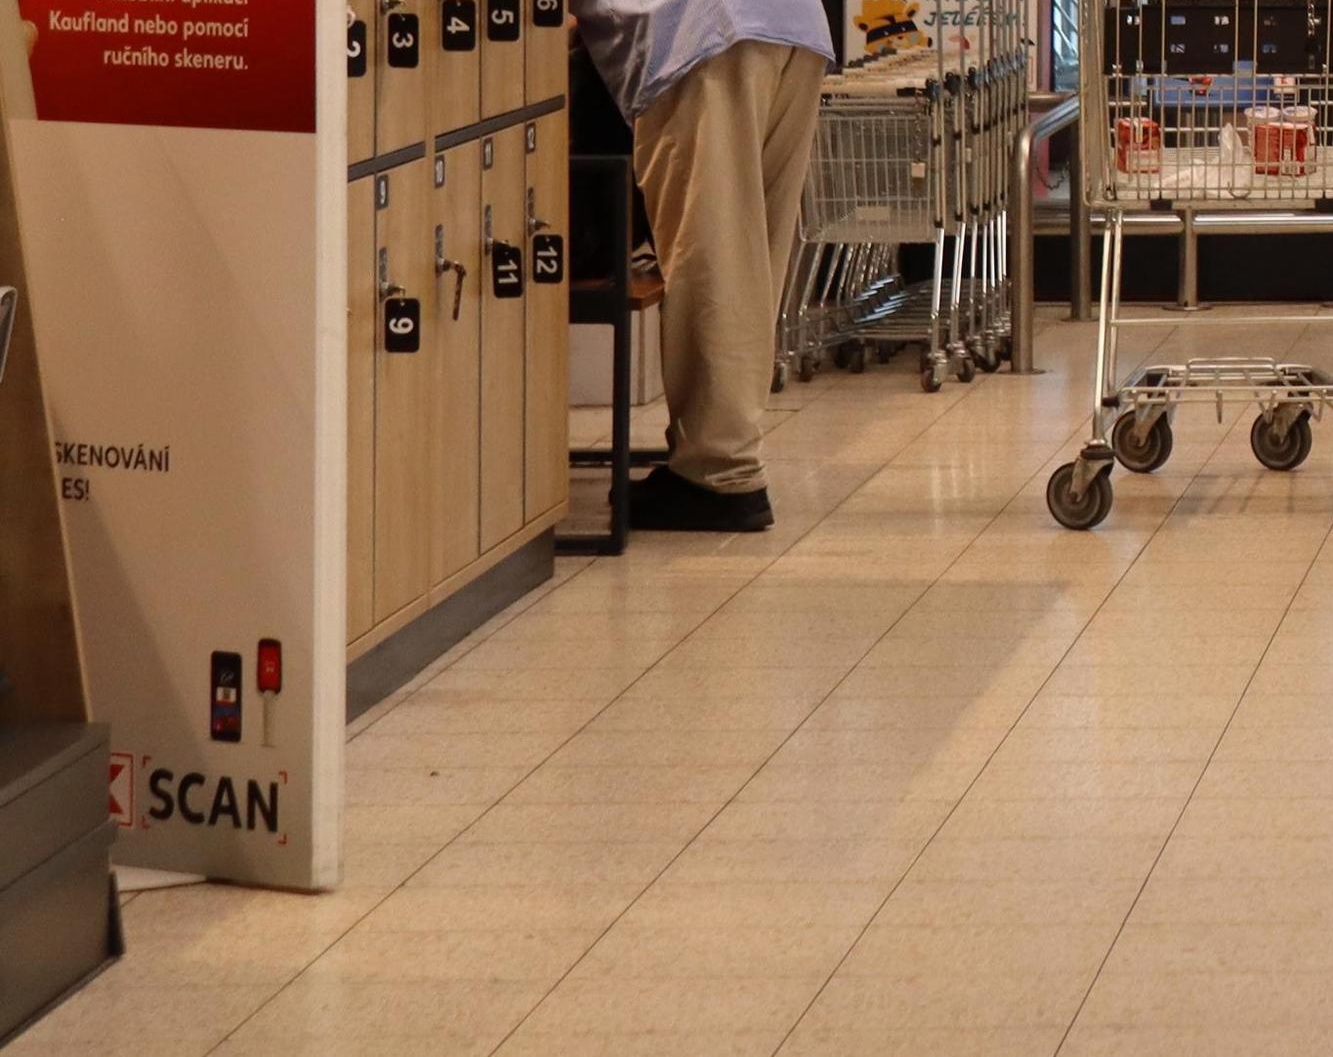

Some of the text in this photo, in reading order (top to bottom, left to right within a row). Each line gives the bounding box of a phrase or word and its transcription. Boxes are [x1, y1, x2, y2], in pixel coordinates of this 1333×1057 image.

[49, 10, 249, 40] Kaufland nebo pomocí
[446, 16, 470, 34] 4
[491, 8, 515, 25] 5
[392, 32, 414, 49] 3
[103, 45, 249, 70] ručního skeneru.
[497, 259, 519, 284] 11
[536, 245, 558, 274] 12
[388, 317, 414, 334] 9
[149, 768, 279, 832] SCAN
